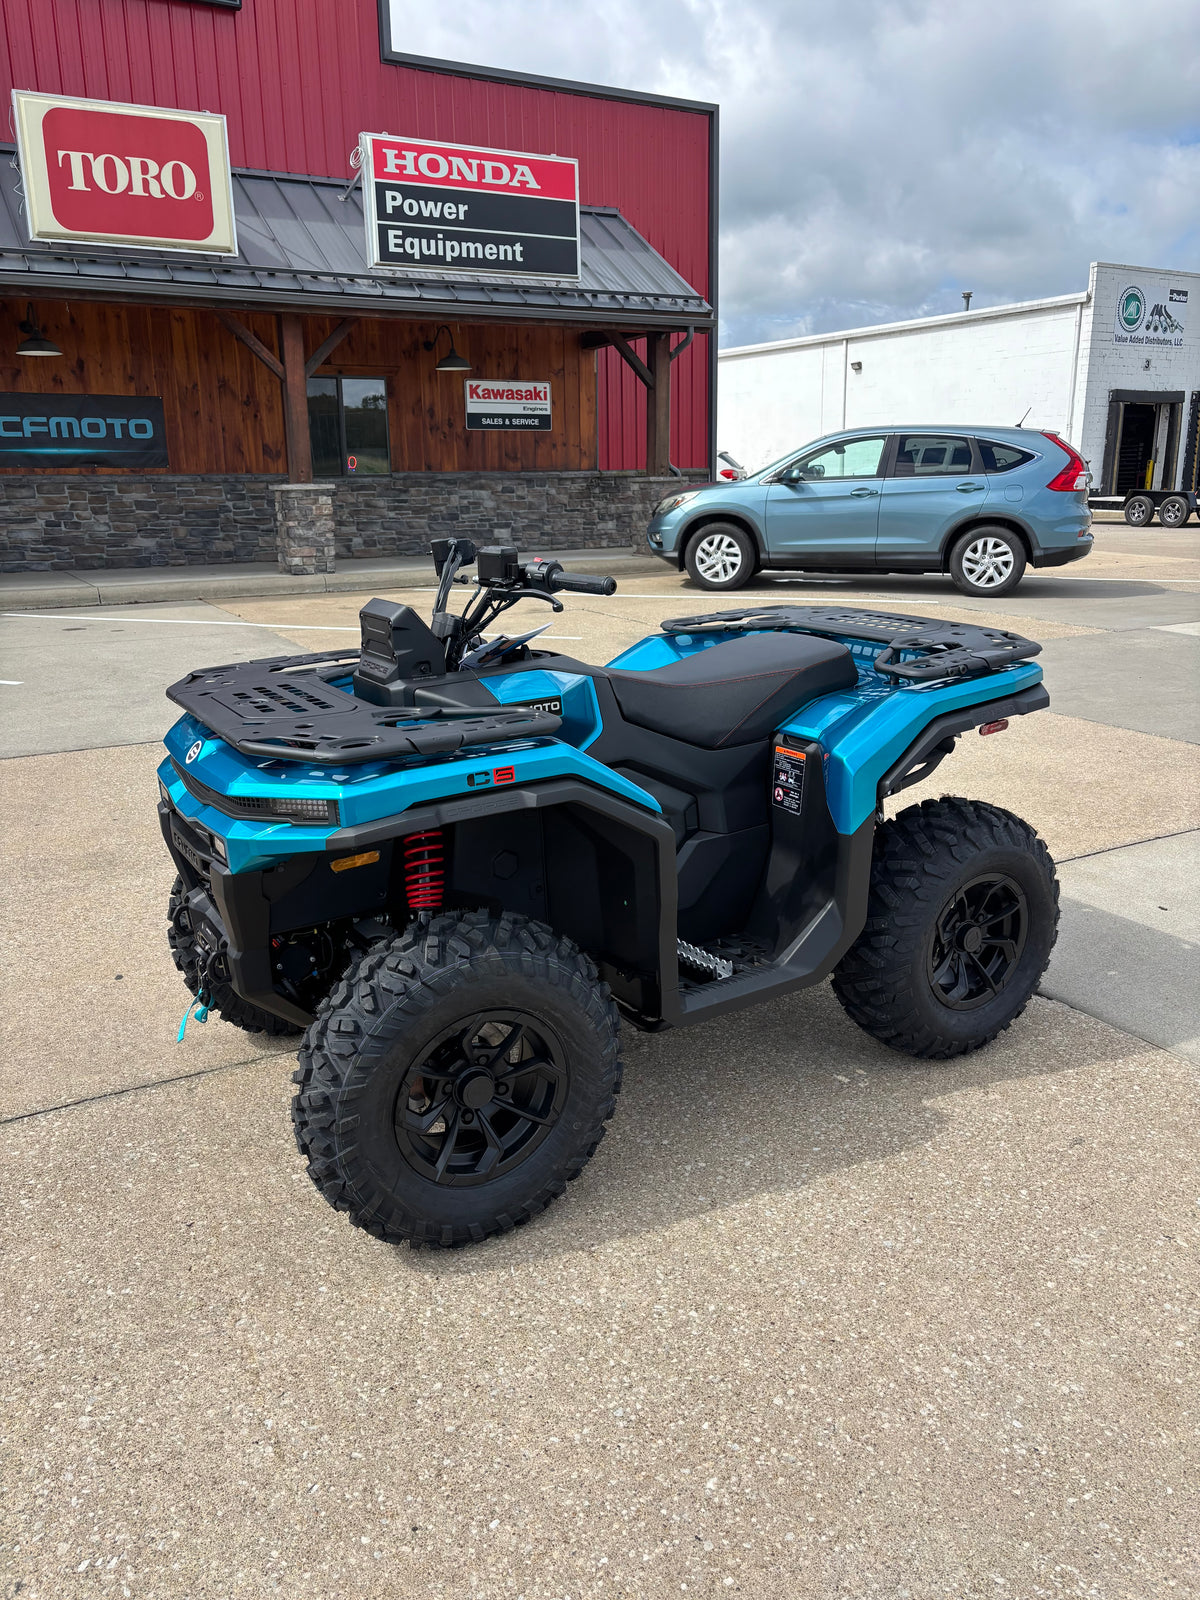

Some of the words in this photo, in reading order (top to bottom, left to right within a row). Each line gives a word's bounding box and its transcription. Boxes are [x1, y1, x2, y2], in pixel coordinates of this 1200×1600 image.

[382, 148, 541, 189] HONDA
[385, 190, 468, 220] Power
[388, 230, 524, 262] Equipment
[1114, 334, 1129, 343] Value
[1129, 335, 1144, 344] Added
[1145, 336, 1174, 346] Distributors,
[1174, 338, 1183, 347] LLC
[1144, 359, 1150, 369] 3
[469, 384, 547, 401] Kawasaki
[0, 416, 154, 439] CFMOTO
[512, 418, 540, 426] SERVICE
